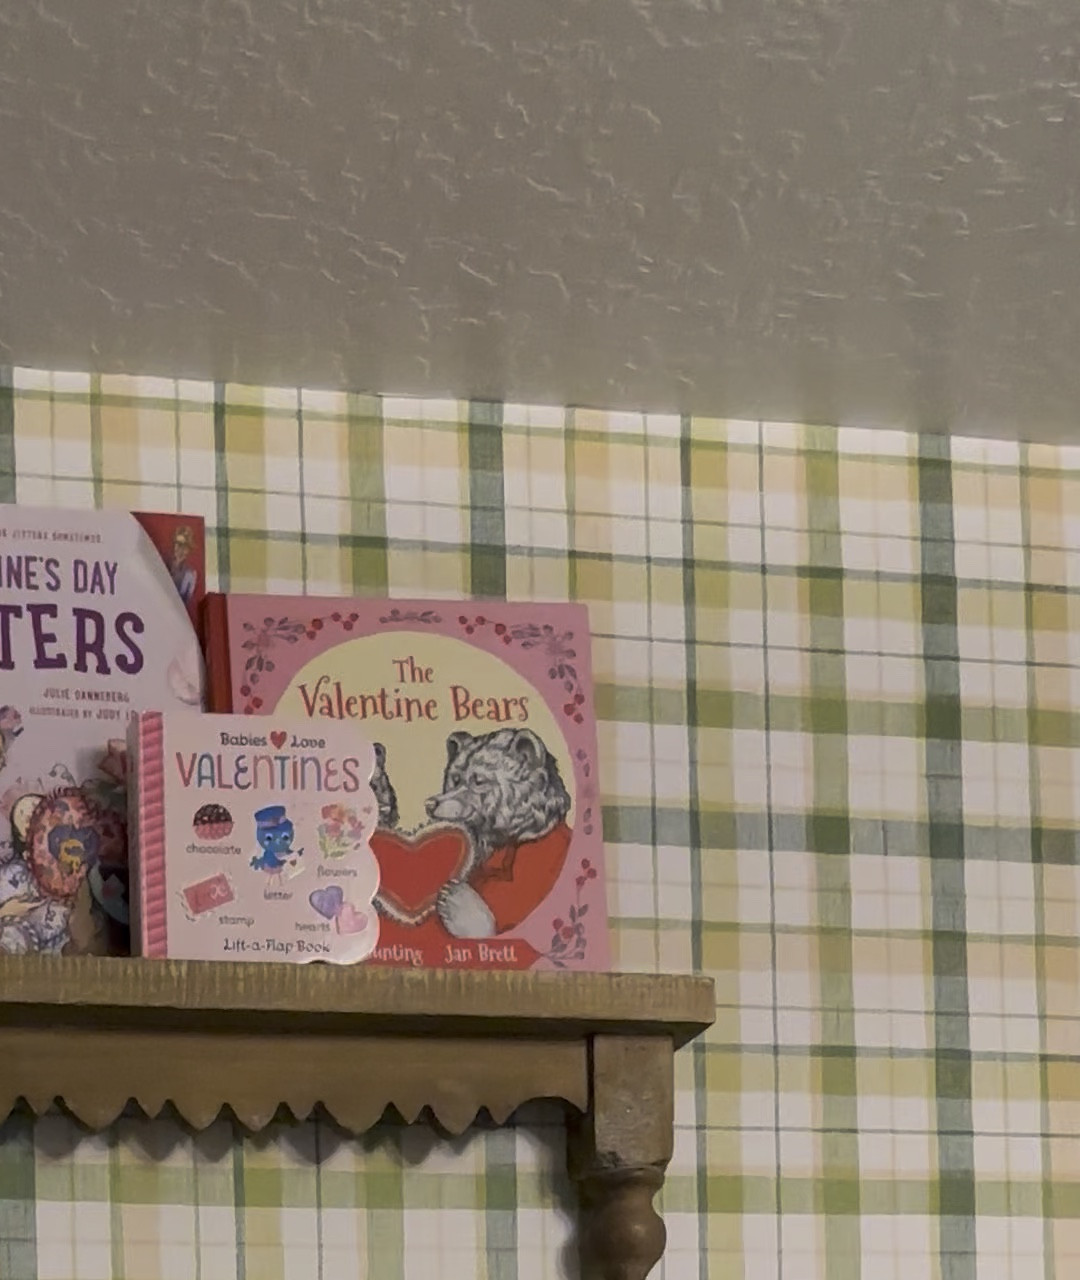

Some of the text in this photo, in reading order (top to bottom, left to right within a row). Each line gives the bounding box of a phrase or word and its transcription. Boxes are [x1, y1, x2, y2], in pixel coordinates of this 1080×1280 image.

[73, 559, 119, 596] DAY
[392, 656, 434, 683] The
[43, 688, 70, 700] JULIE
[298, 675, 529, 722] Valentine Bears
[220, 732, 326, 748] Babies Love
[186, 843, 242, 855] chocolate
[317, 865, 358, 878] flowers
[263, 889, 293, 900] letter
[218, 915, 255, 928] stamp
[295, 920, 331, 932] hearts
[297, 940, 331, 953] Book
[371, 943, 518, 965] unting Jan Brett
